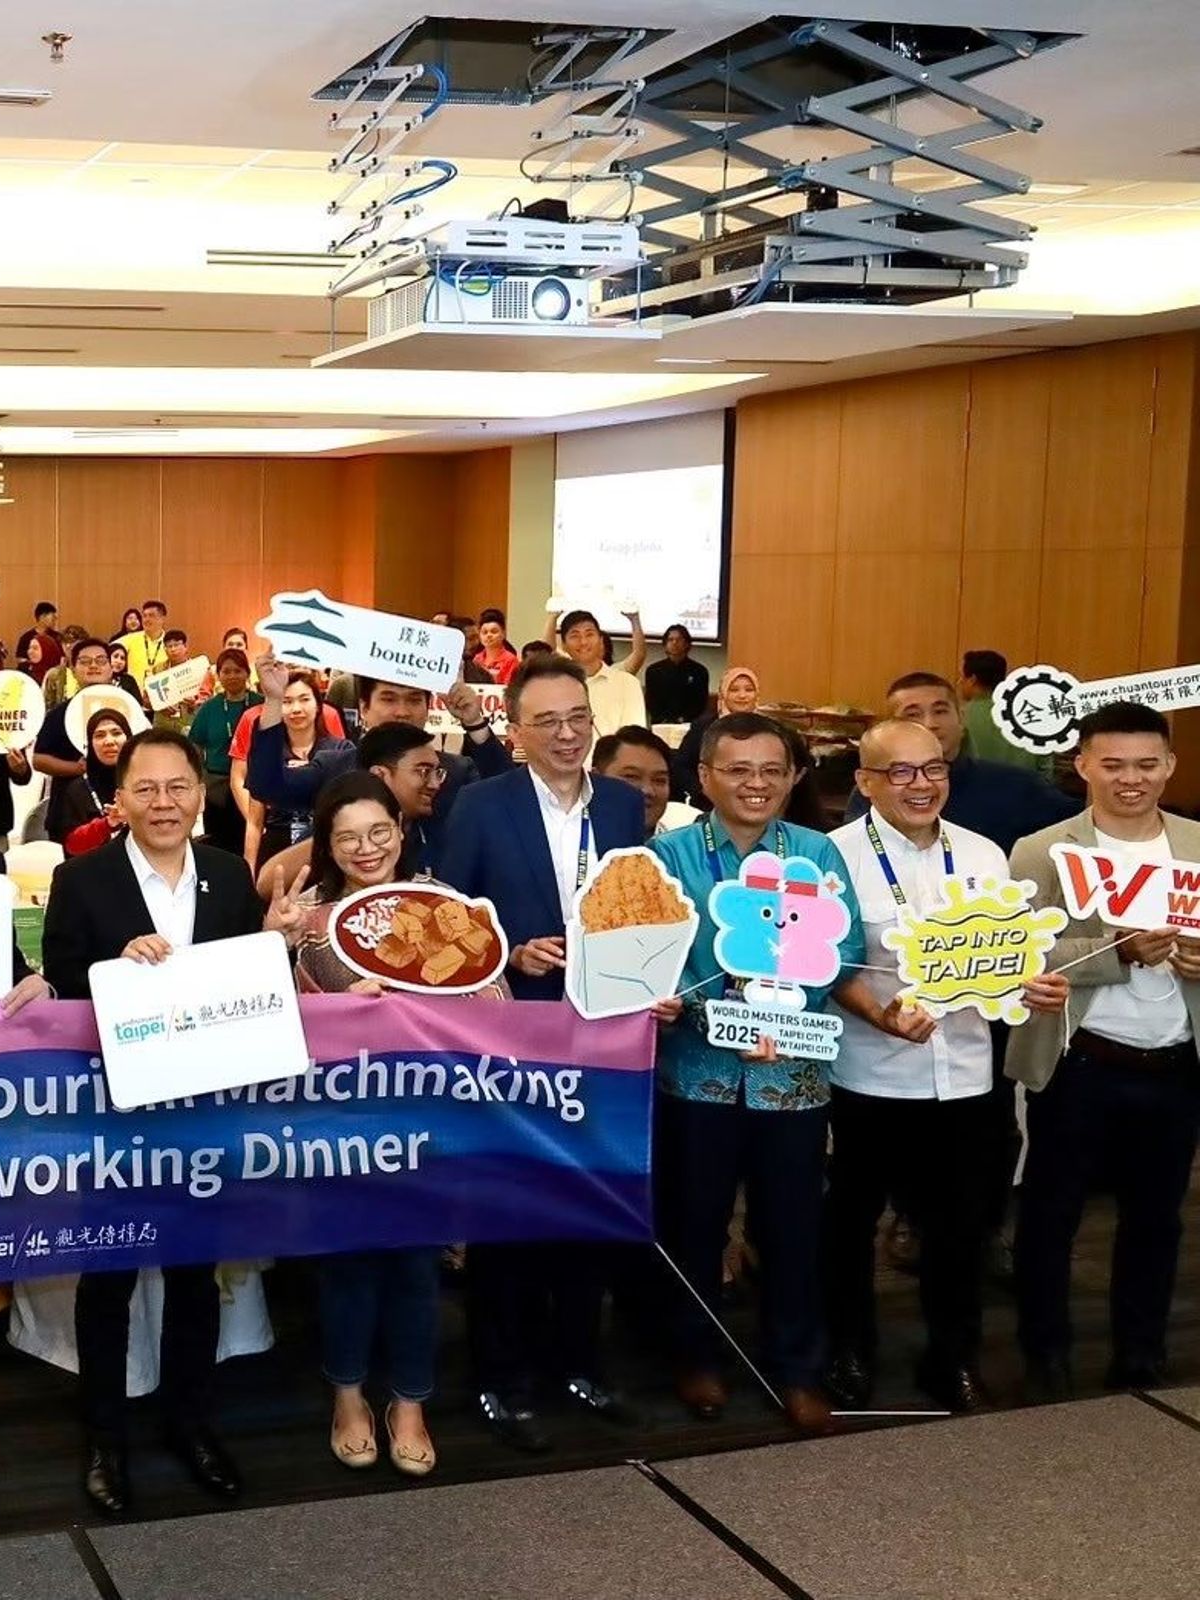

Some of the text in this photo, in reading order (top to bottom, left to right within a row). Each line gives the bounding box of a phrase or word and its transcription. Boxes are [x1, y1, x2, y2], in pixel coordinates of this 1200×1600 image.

[369, 641, 450, 674] boutech
[1016, 694, 1077, 725] 全輪
[920, 928, 1027, 953] TAP INTO
[920, 952, 1026, 983] TAIPEI
[115, 1020, 166, 1041] taipei
[712, 1005, 838, 1031] WORLD MASTERS GAMES
[714, 1023, 760, 1045] 2025
[778, 1029, 824, 1042] TAIPEI CITY
[774, 1040, 833, 1054] EW TAIPEI CITY
[241, 1125, 430, 1181] Dinner
